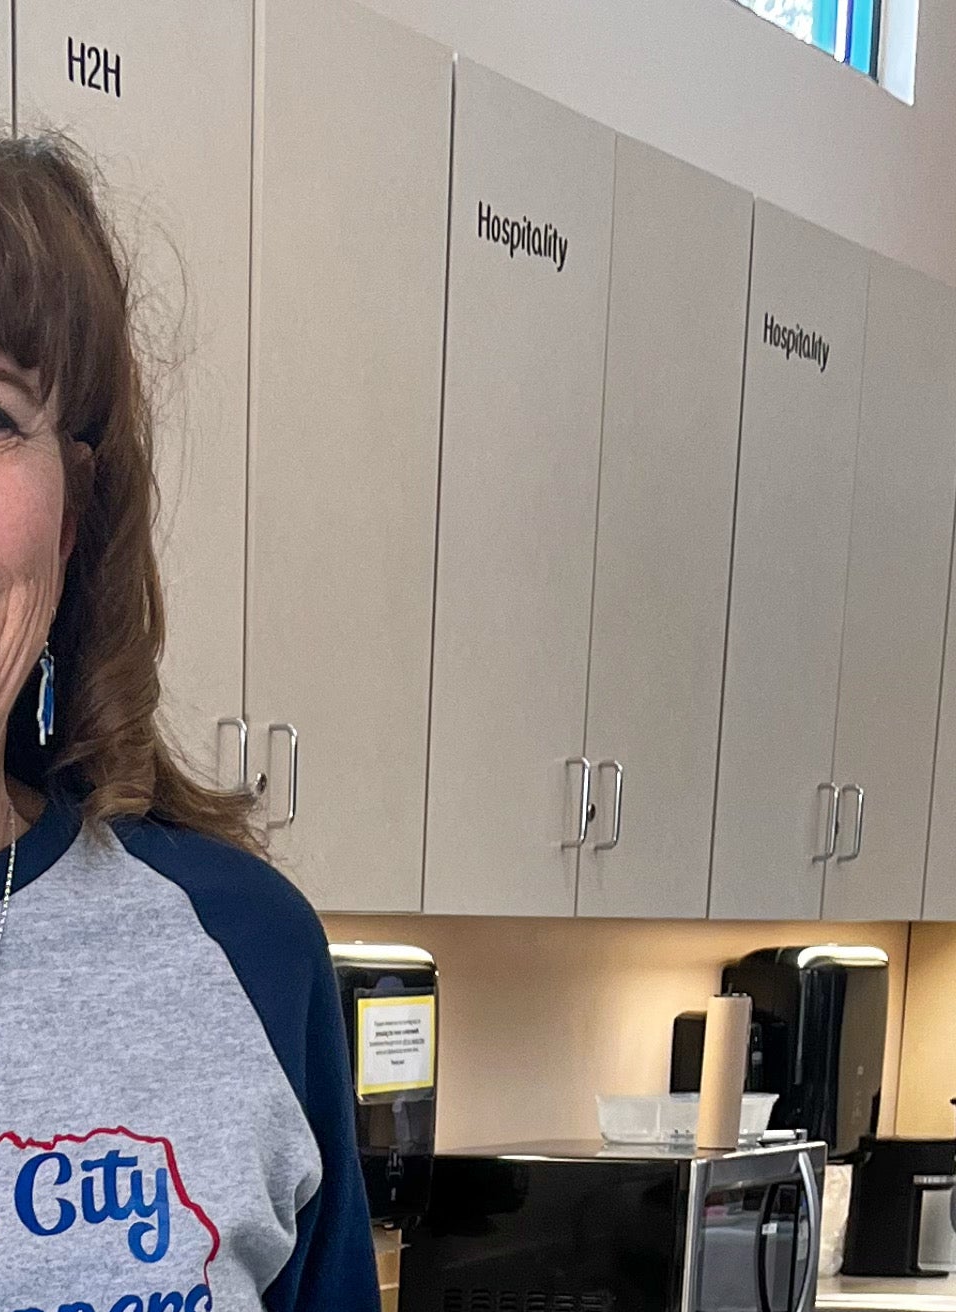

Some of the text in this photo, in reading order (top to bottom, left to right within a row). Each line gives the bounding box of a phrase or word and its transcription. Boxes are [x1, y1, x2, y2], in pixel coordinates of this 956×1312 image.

[68, 36, 121, 98] H2H
[478, 200, 568, 272] Hospitality
[763, 312, 829, 373] Hospitality
[14, 1150, 168, 1263] City
